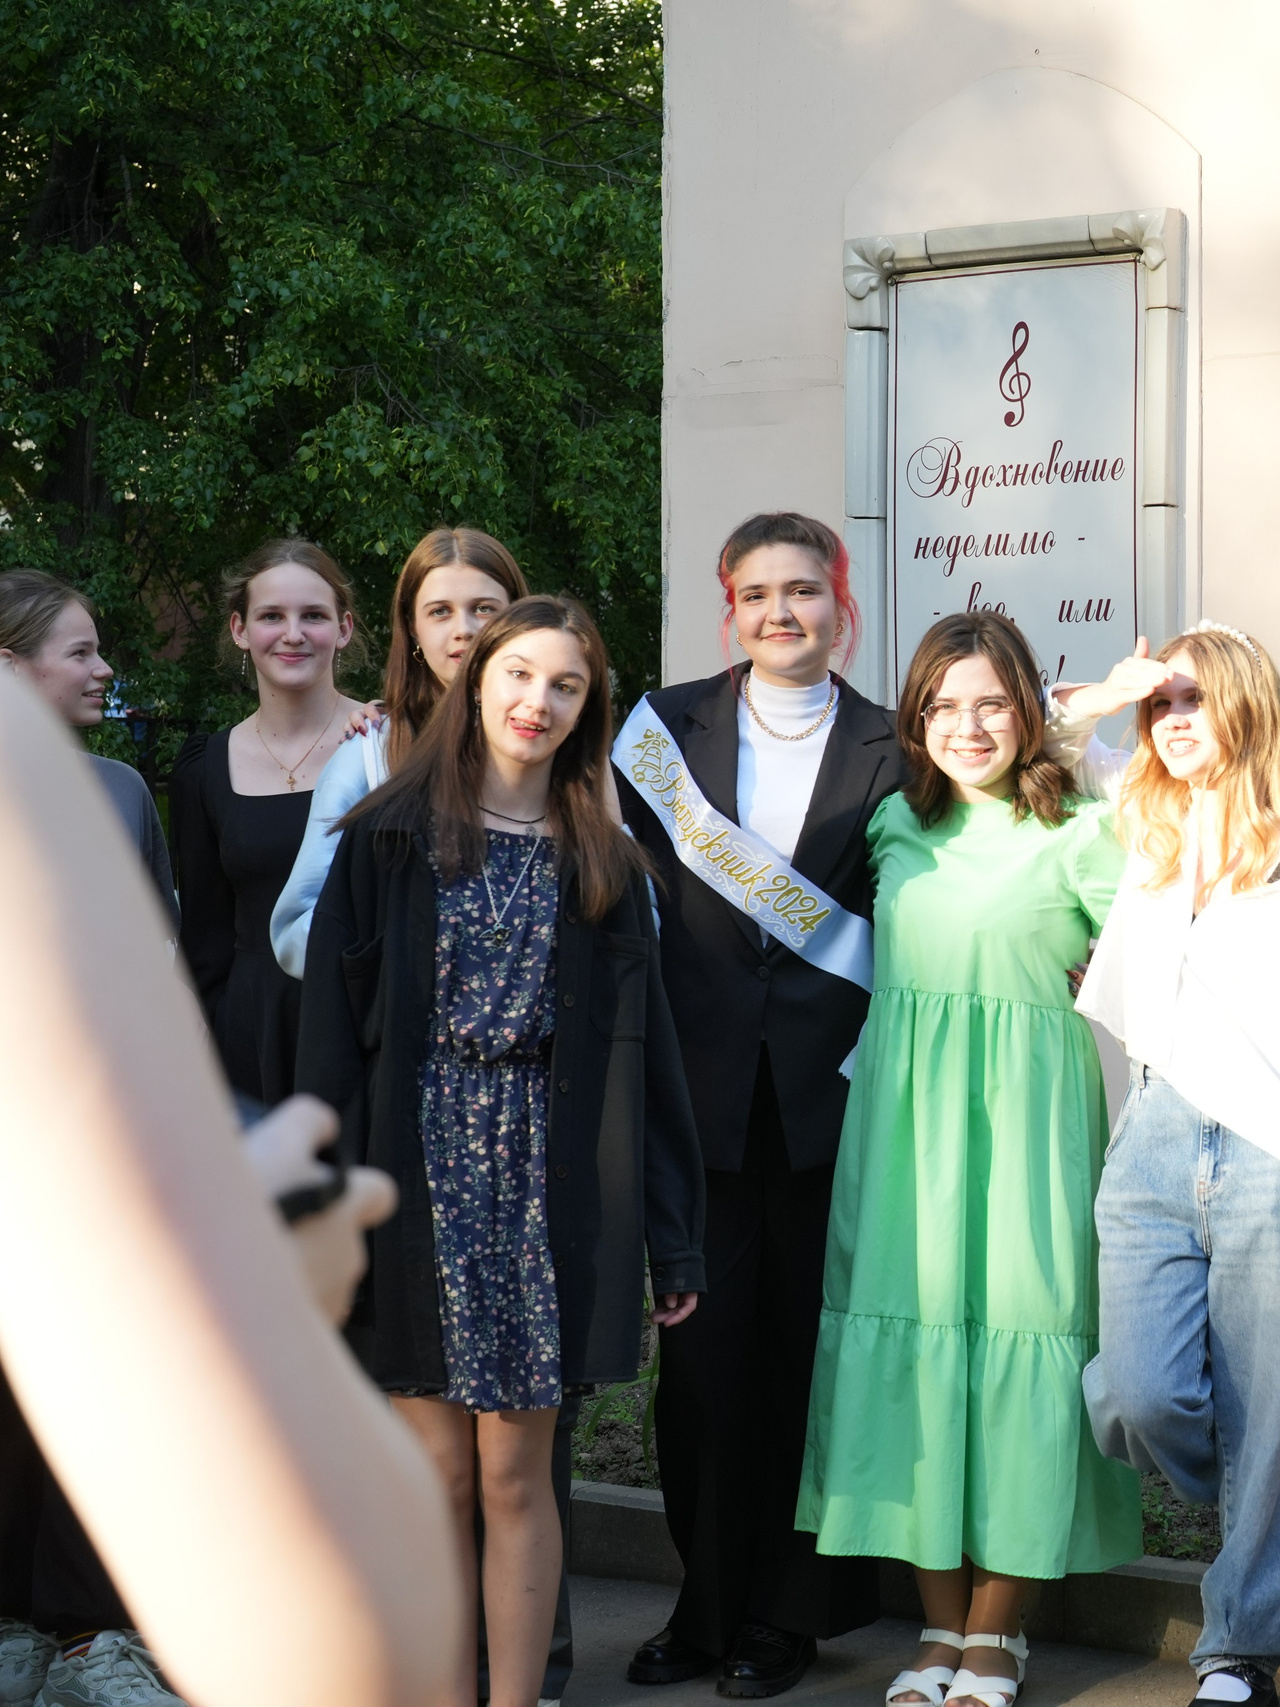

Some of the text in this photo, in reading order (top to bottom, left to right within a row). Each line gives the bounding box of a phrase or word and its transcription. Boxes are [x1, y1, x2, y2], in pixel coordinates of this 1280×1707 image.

[906, 436, 1126, 509] Вдохновение
[913, 530, 1056, 578] неделимо
[1058, 598, 1115, 623] или
[650, 760, 831, 934] Выпускник 2024
